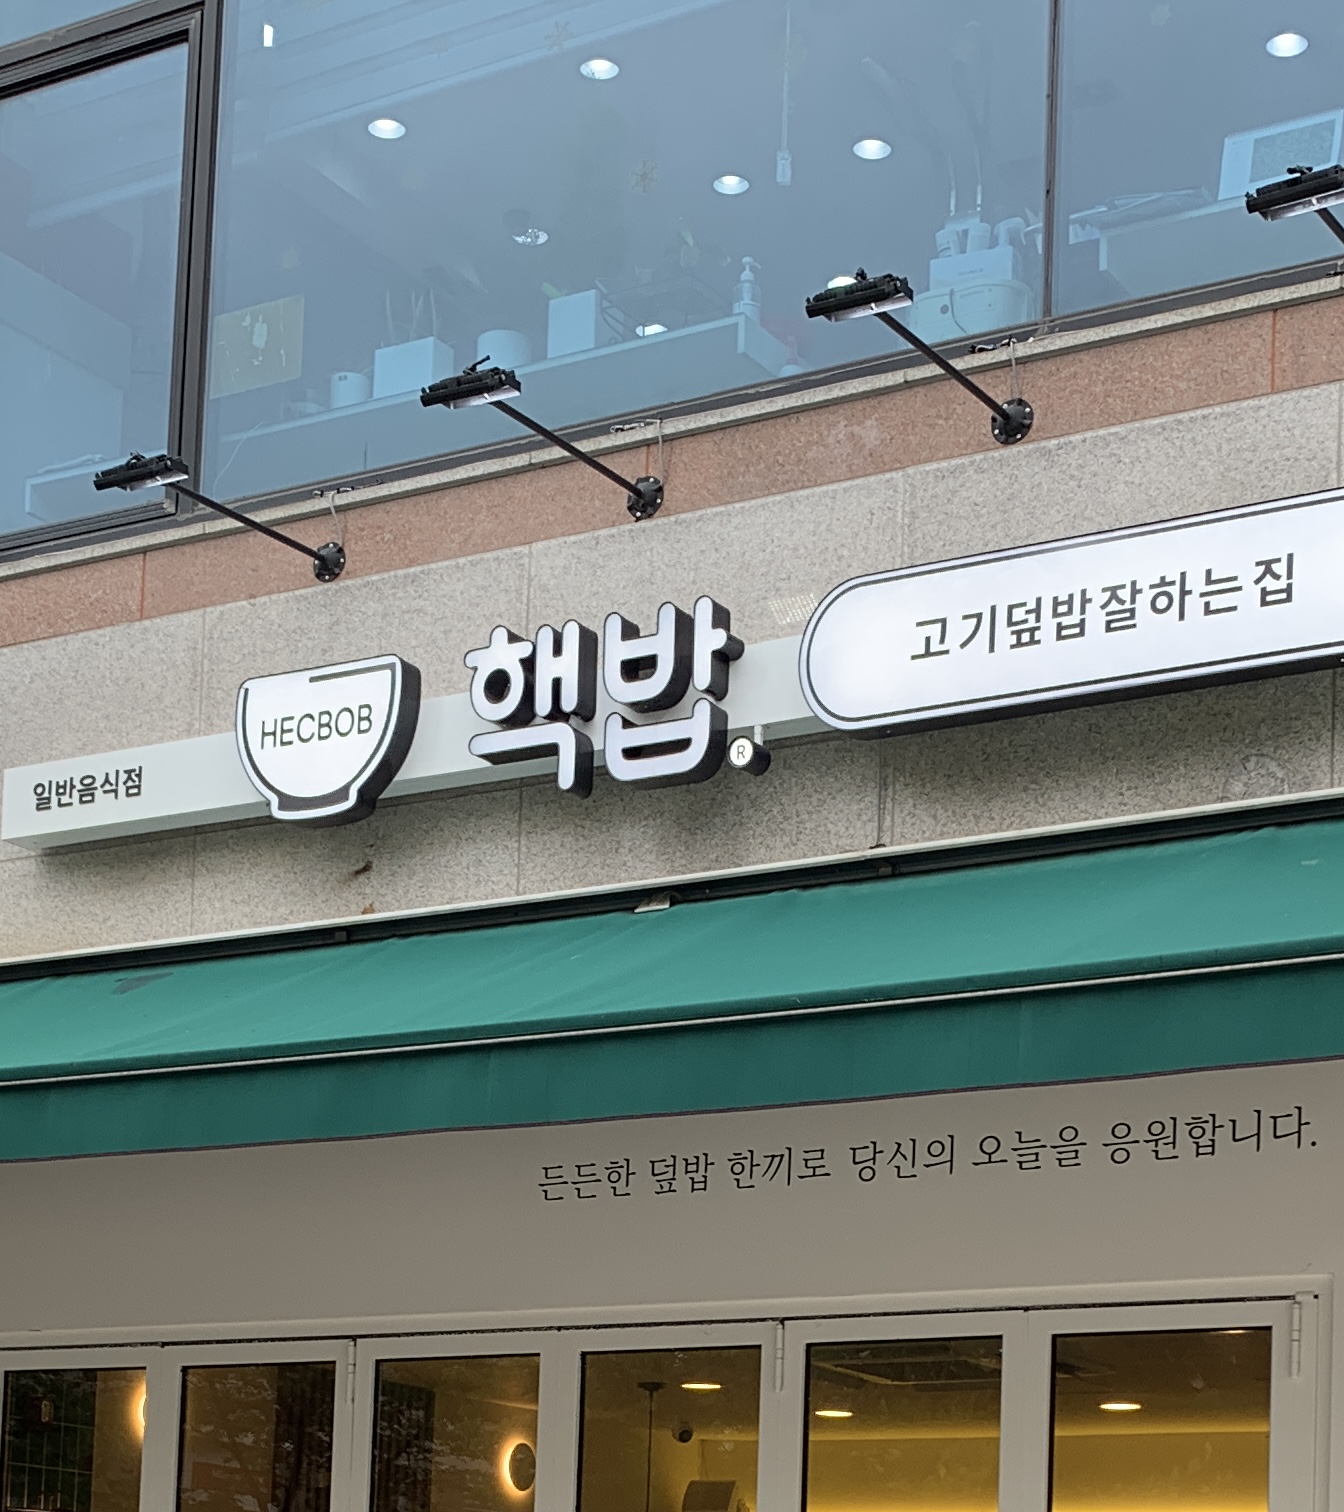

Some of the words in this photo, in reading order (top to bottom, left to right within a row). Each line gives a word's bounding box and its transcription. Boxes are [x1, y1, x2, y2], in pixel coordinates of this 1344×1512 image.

[908, 550, 1299, 663] 고기덮밥잘하는집
[259, 704, 374, 750] HECBOB
[463, 594, 743, 802] 핵밥
[31, 764, 145, 812] 일반음식점
[537, 1157, 637, 1203] 든든한
[650, 1151, 716, 1197] 덮밥
[727, 1145, 832, 1190] 한끼로
[847, 1132, 959, 1185] 당신의
[971, 1125, 1089, 1173] 오늘을
[1101, 1105, 1318, 1165] 응원합니다.
